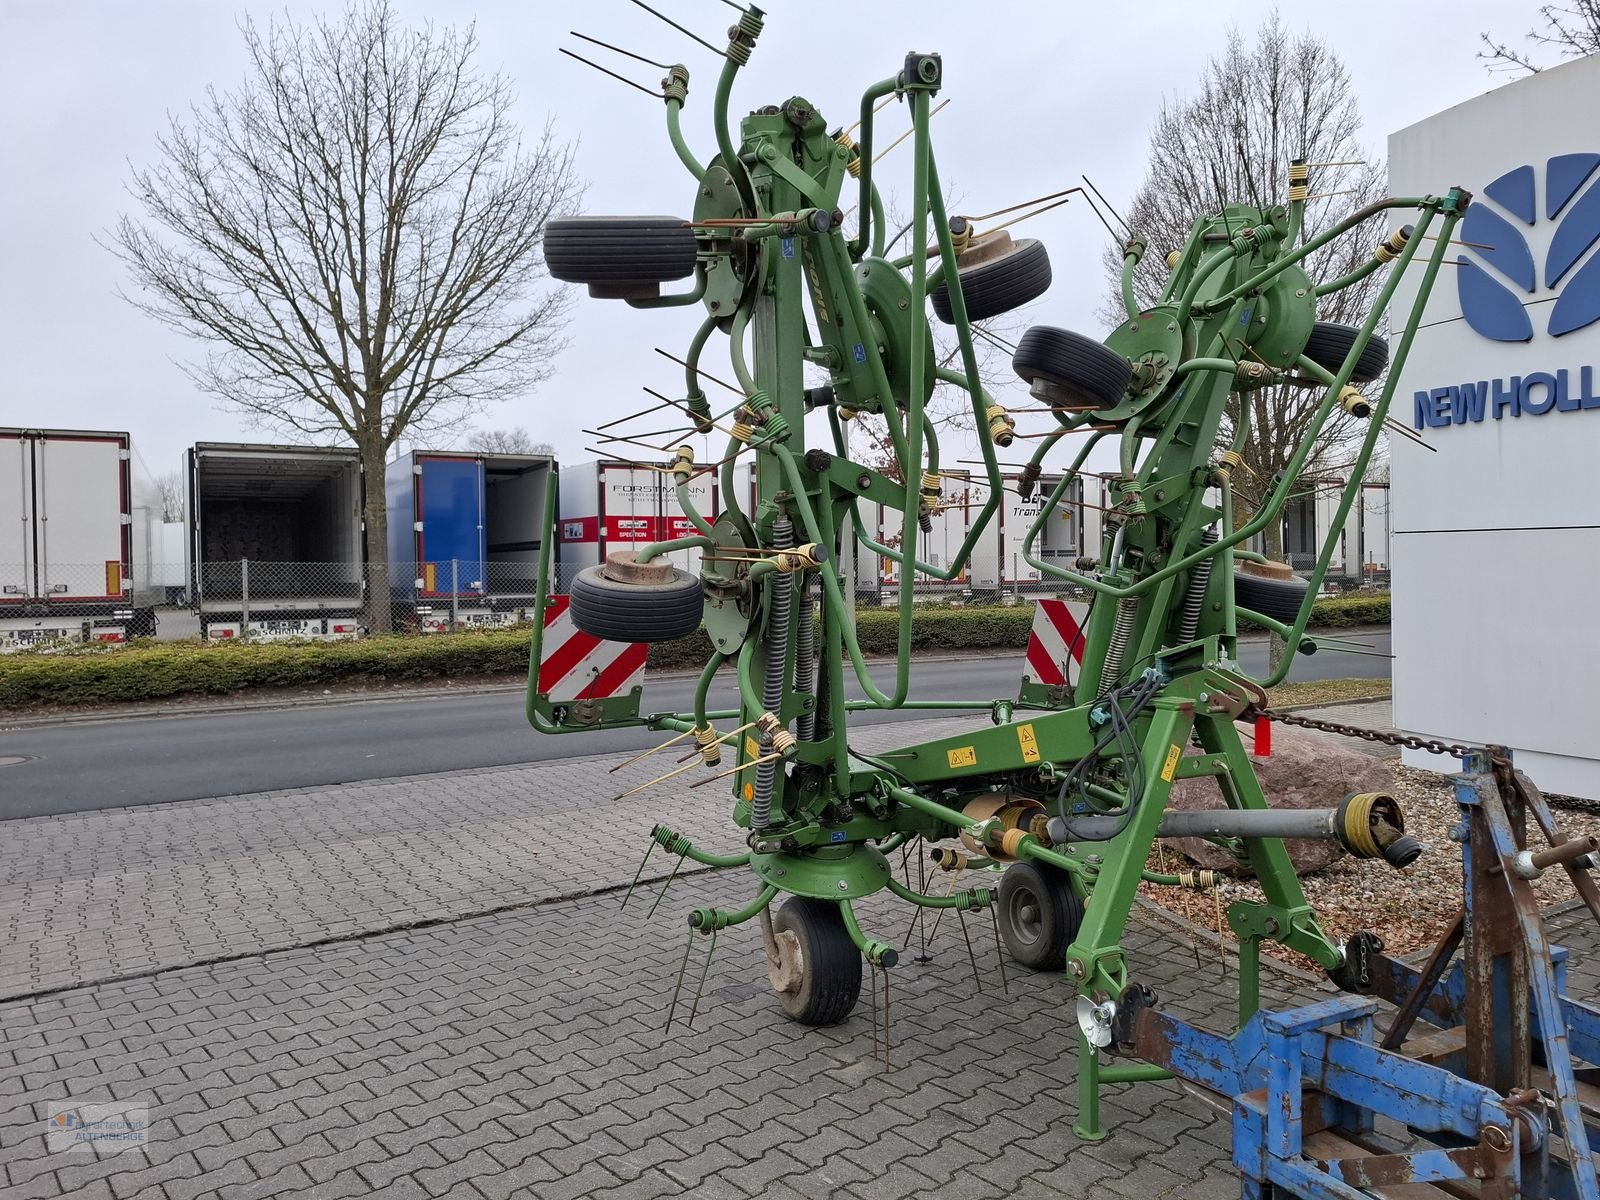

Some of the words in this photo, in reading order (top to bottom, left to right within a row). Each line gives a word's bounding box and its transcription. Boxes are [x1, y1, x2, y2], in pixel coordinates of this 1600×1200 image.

[1414, 381, 1488, 430] NEW
[1492, 365, 1600, 421] HOLL
[613, 485, 705, 494] FORSTMNN
